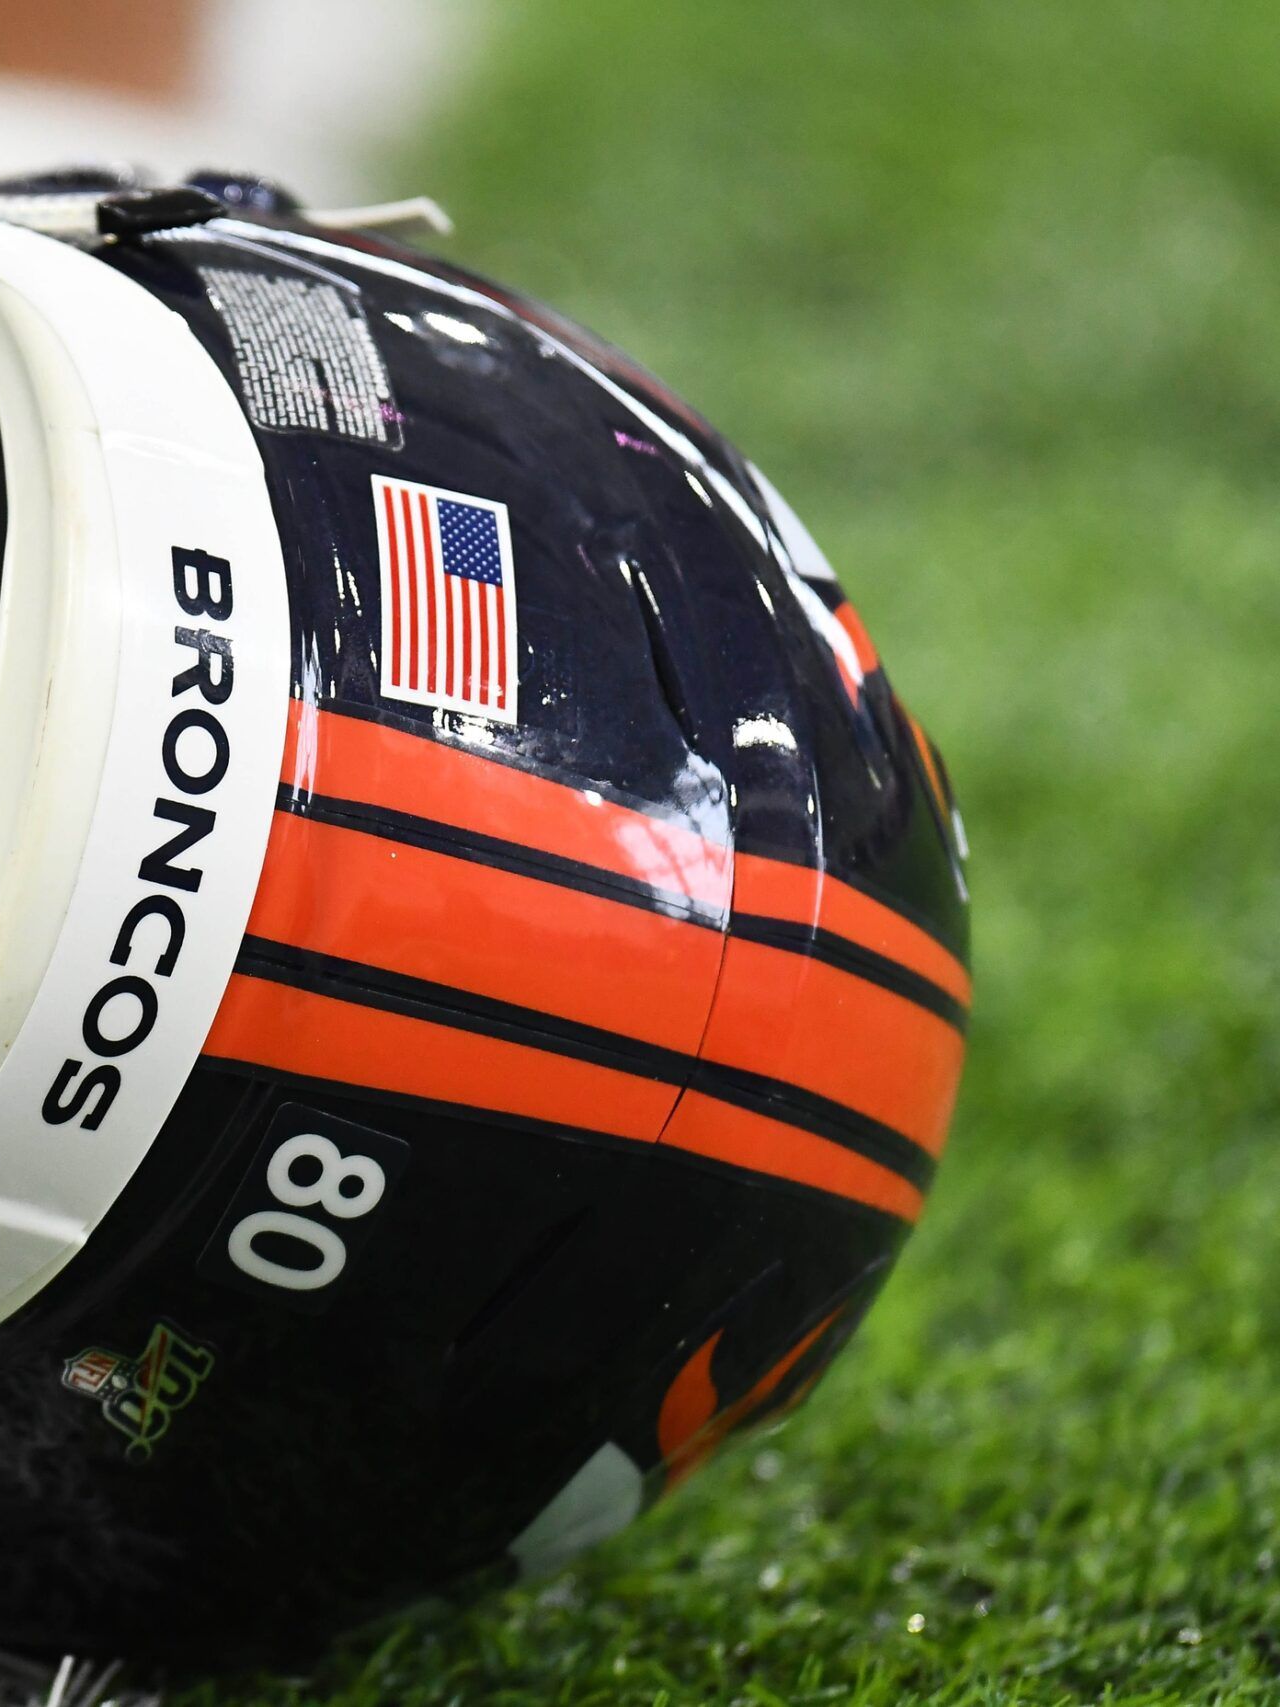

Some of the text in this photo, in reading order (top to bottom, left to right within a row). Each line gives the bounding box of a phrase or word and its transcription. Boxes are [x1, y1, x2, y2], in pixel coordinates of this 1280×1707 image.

[41, 545, 234, 1131] BRONCOS
[228, 1133, 386, 1291] 80
[70, 1351, 120, 1389] NFL
